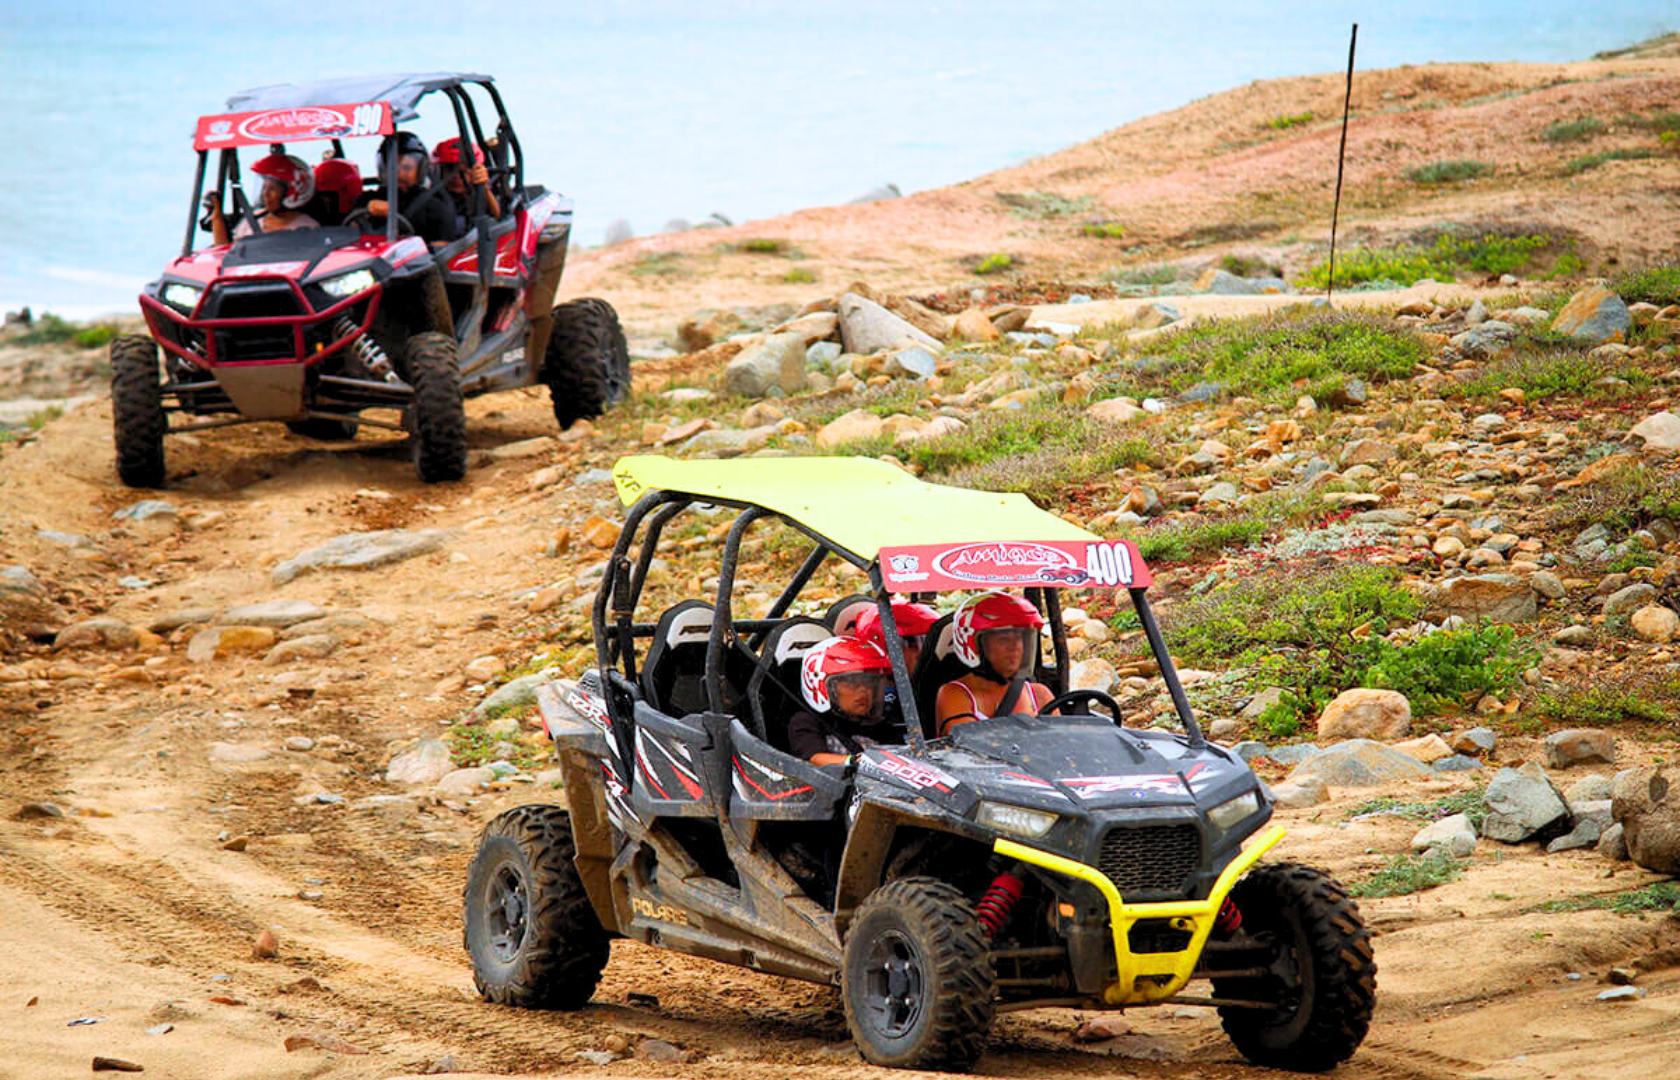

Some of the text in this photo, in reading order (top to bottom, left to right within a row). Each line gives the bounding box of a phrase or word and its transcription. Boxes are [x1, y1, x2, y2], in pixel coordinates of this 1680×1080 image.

[353, 104, 382, 136] 190
[1086, 543, 1133, 586] 400
[632, 896, 689, 926] POLARIS
